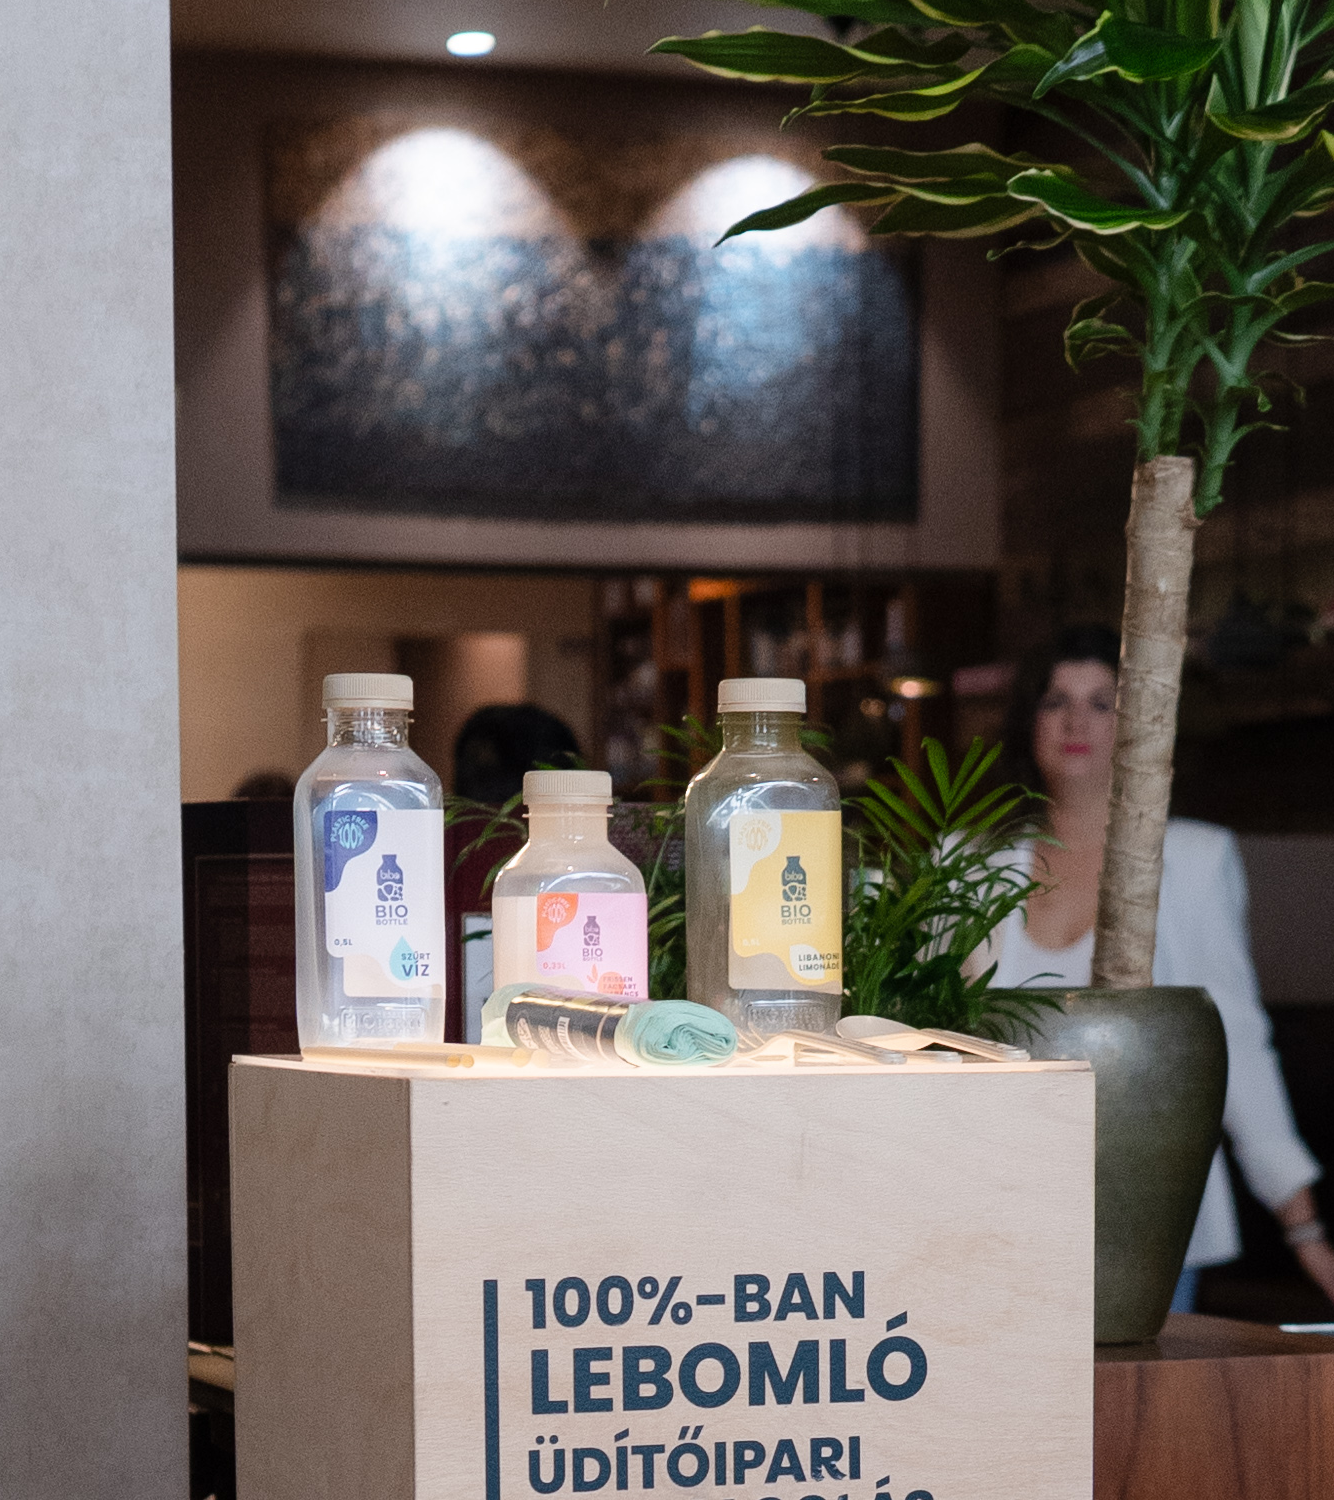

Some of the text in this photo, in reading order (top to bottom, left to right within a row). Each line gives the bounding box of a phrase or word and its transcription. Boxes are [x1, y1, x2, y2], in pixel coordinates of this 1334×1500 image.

[375, 904, 409, 918] BIO
[781, 904, 812, 918] BIO
[375, 918, 409, 926] BOTTLE
[582, 947, 603, 957] BIO
[402, 961, 430, 977] VÍZ
[525, 1270, 866, 1329] 100%-BAN
[531, 1310, 929, 1415] LEBOMLÓ
[528, 1425, 862, 1494] ÜDÍTŐIPARI
